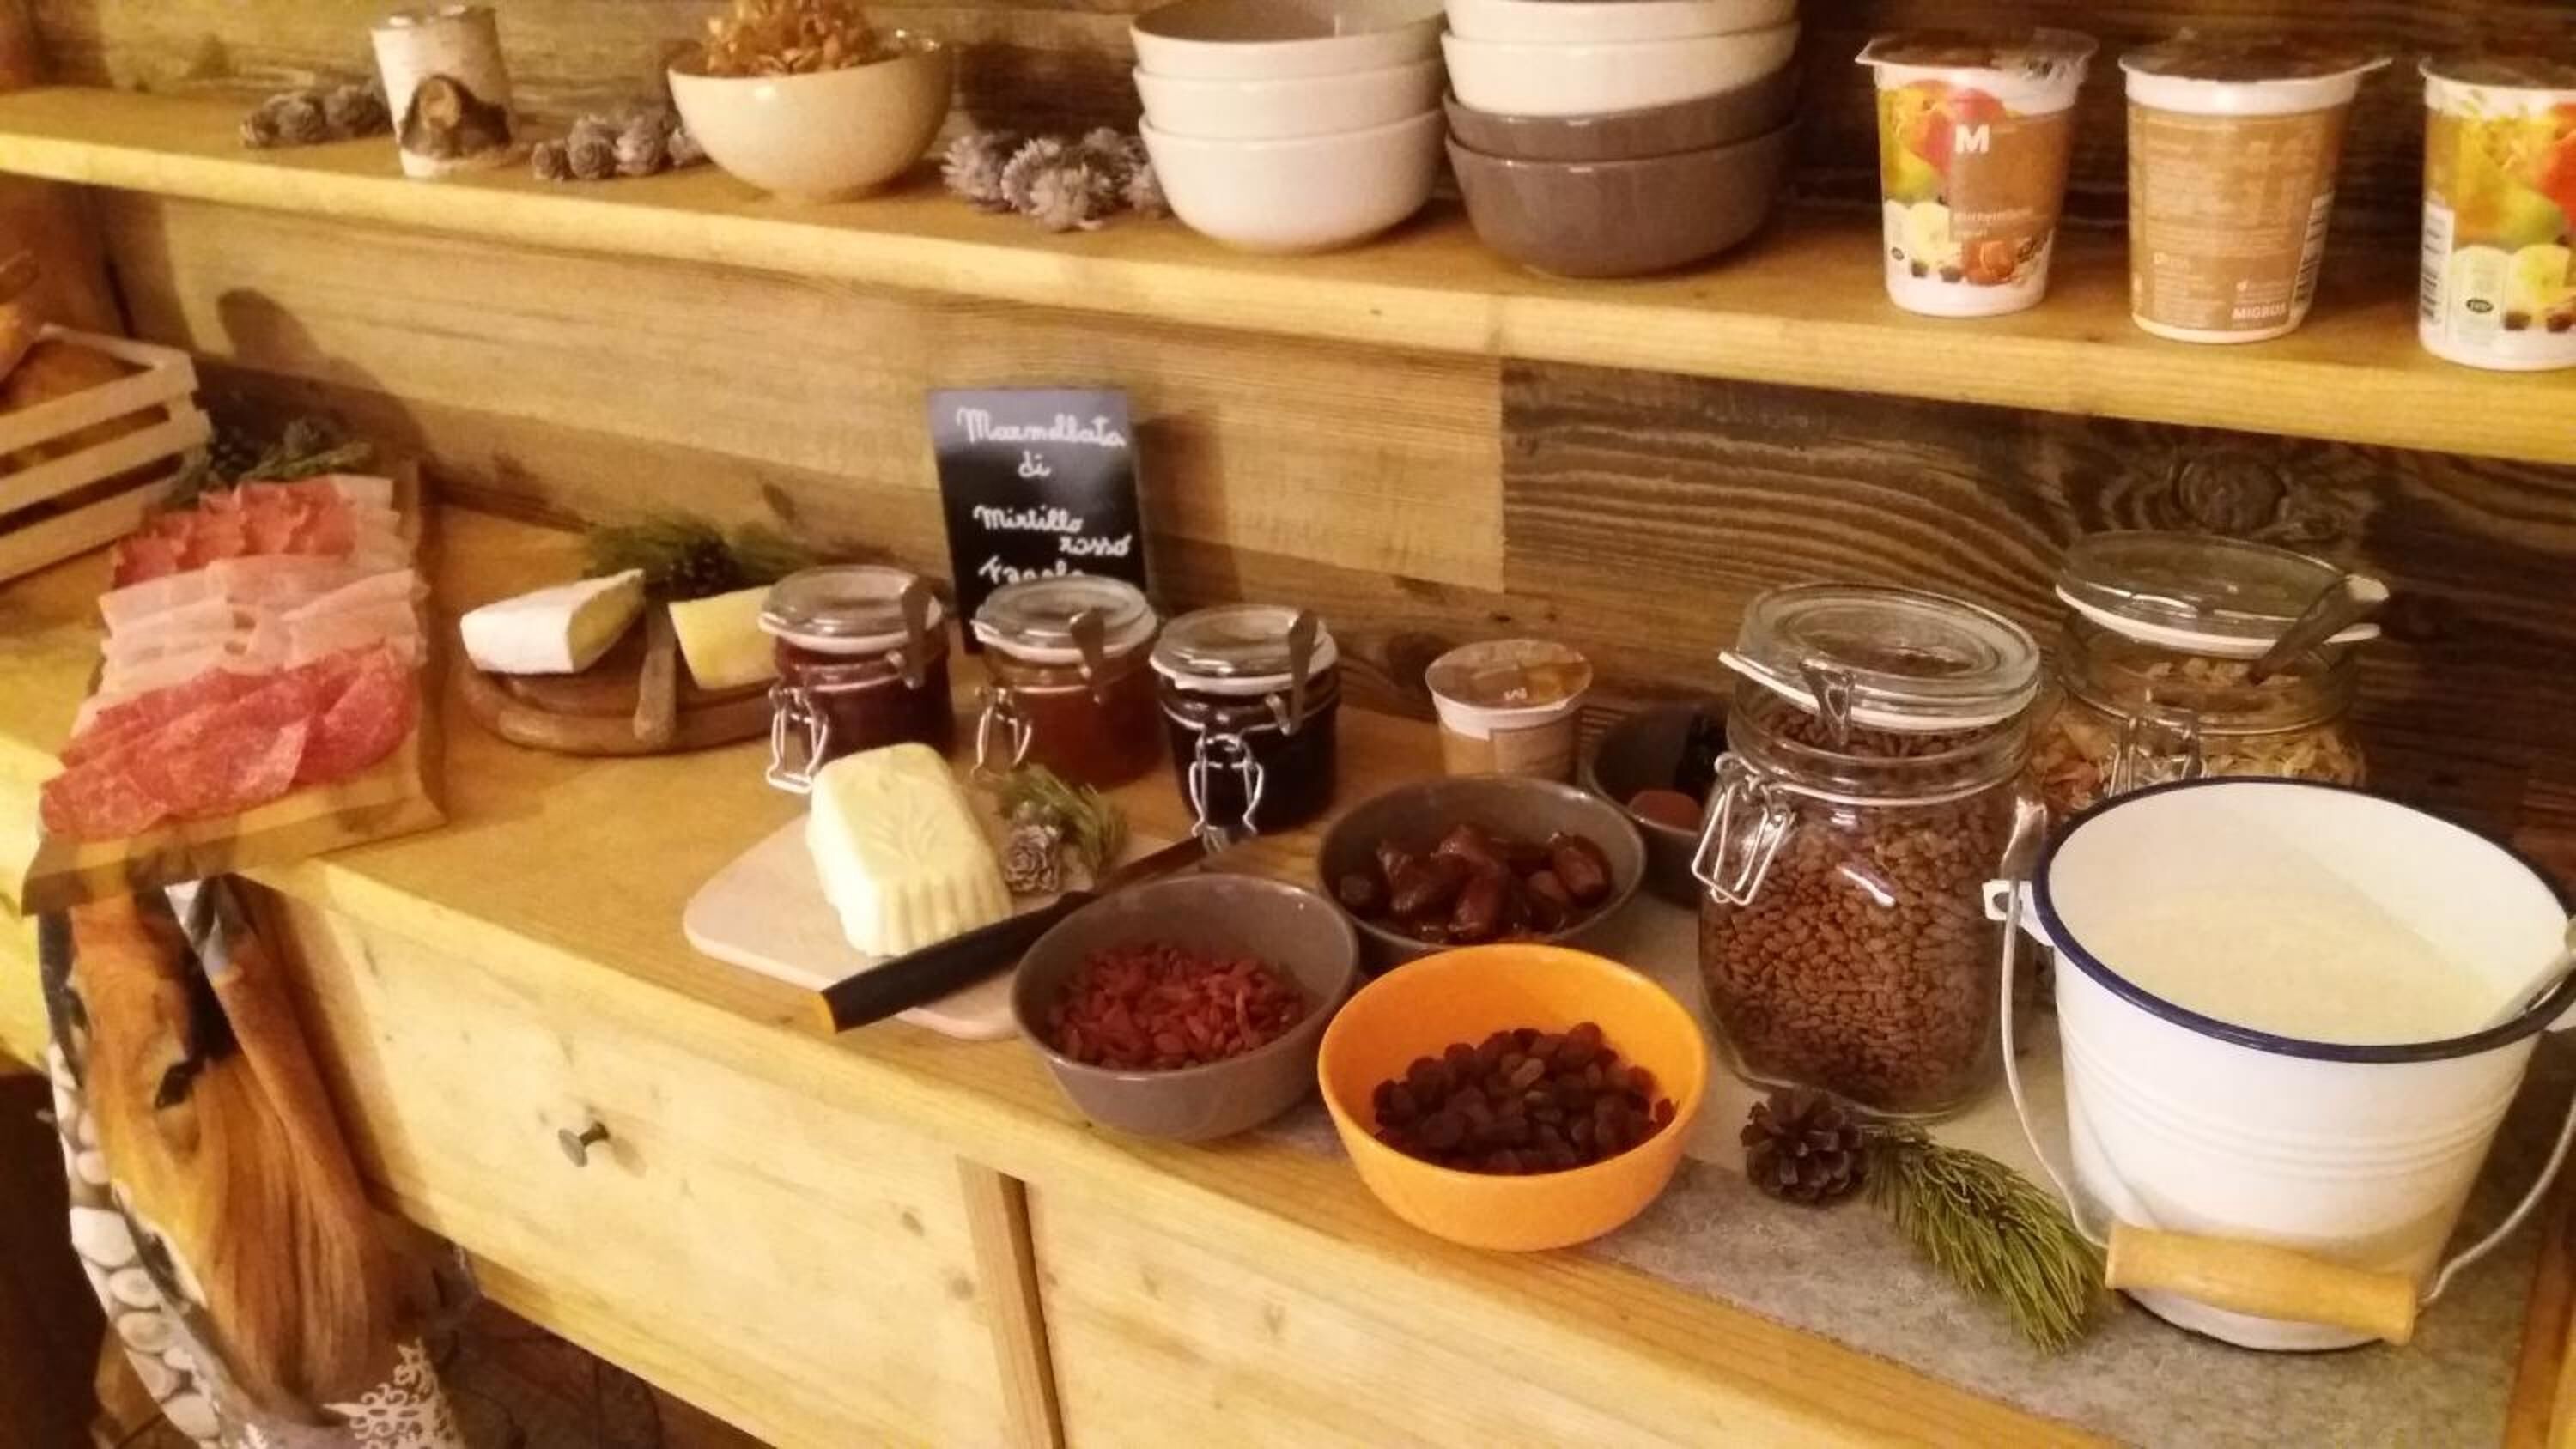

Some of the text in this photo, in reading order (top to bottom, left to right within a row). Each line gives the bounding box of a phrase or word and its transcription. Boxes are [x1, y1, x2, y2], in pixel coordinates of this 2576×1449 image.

[1955, 124, 1990, 154] M
[2231, 303, 2287, 320] MIGROS
[1018, 451, 1052, 478] di
[973, 504, 1084, 531] Mirtillo
